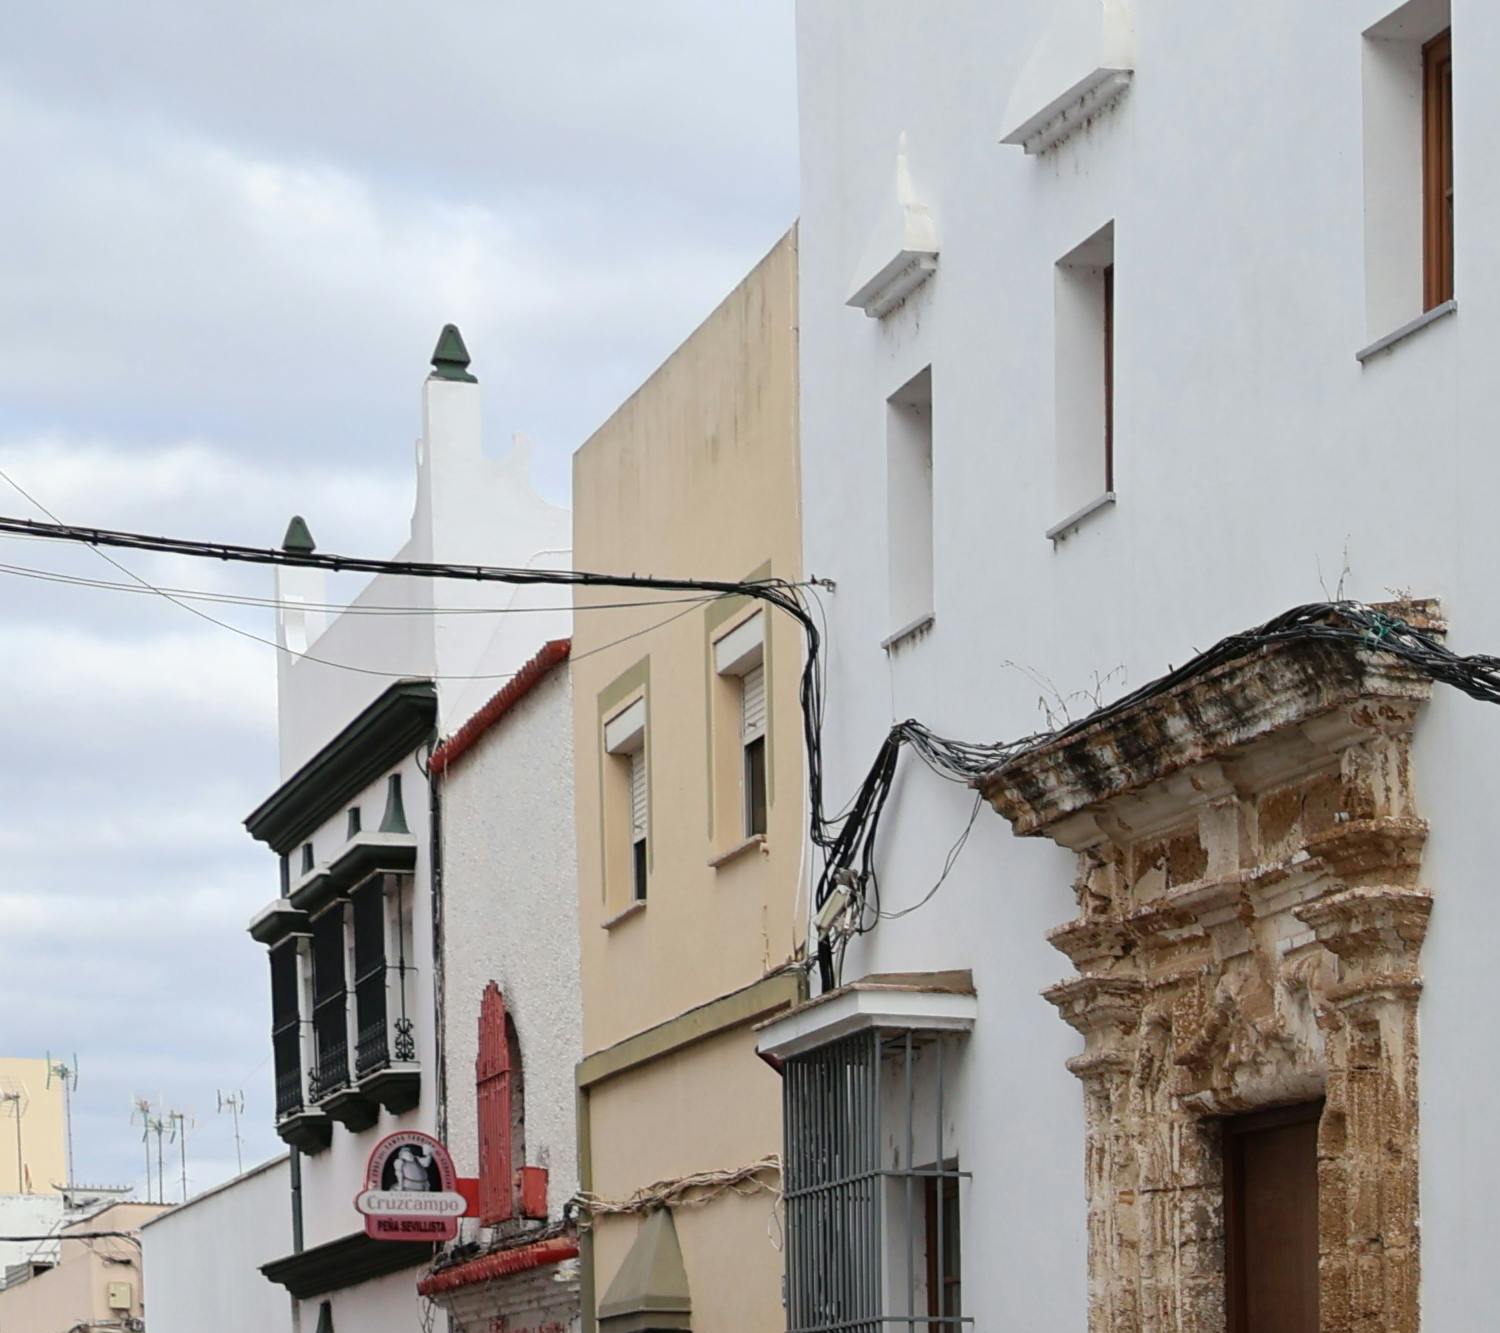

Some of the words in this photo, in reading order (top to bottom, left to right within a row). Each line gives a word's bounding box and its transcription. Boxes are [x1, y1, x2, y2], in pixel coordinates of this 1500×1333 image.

[367, 1194, 459, 1213] Cruzcampo
[377, 1218, 399, 1232] PEÑA
[401, 1221, 446, 1232] SEVILLISTA
